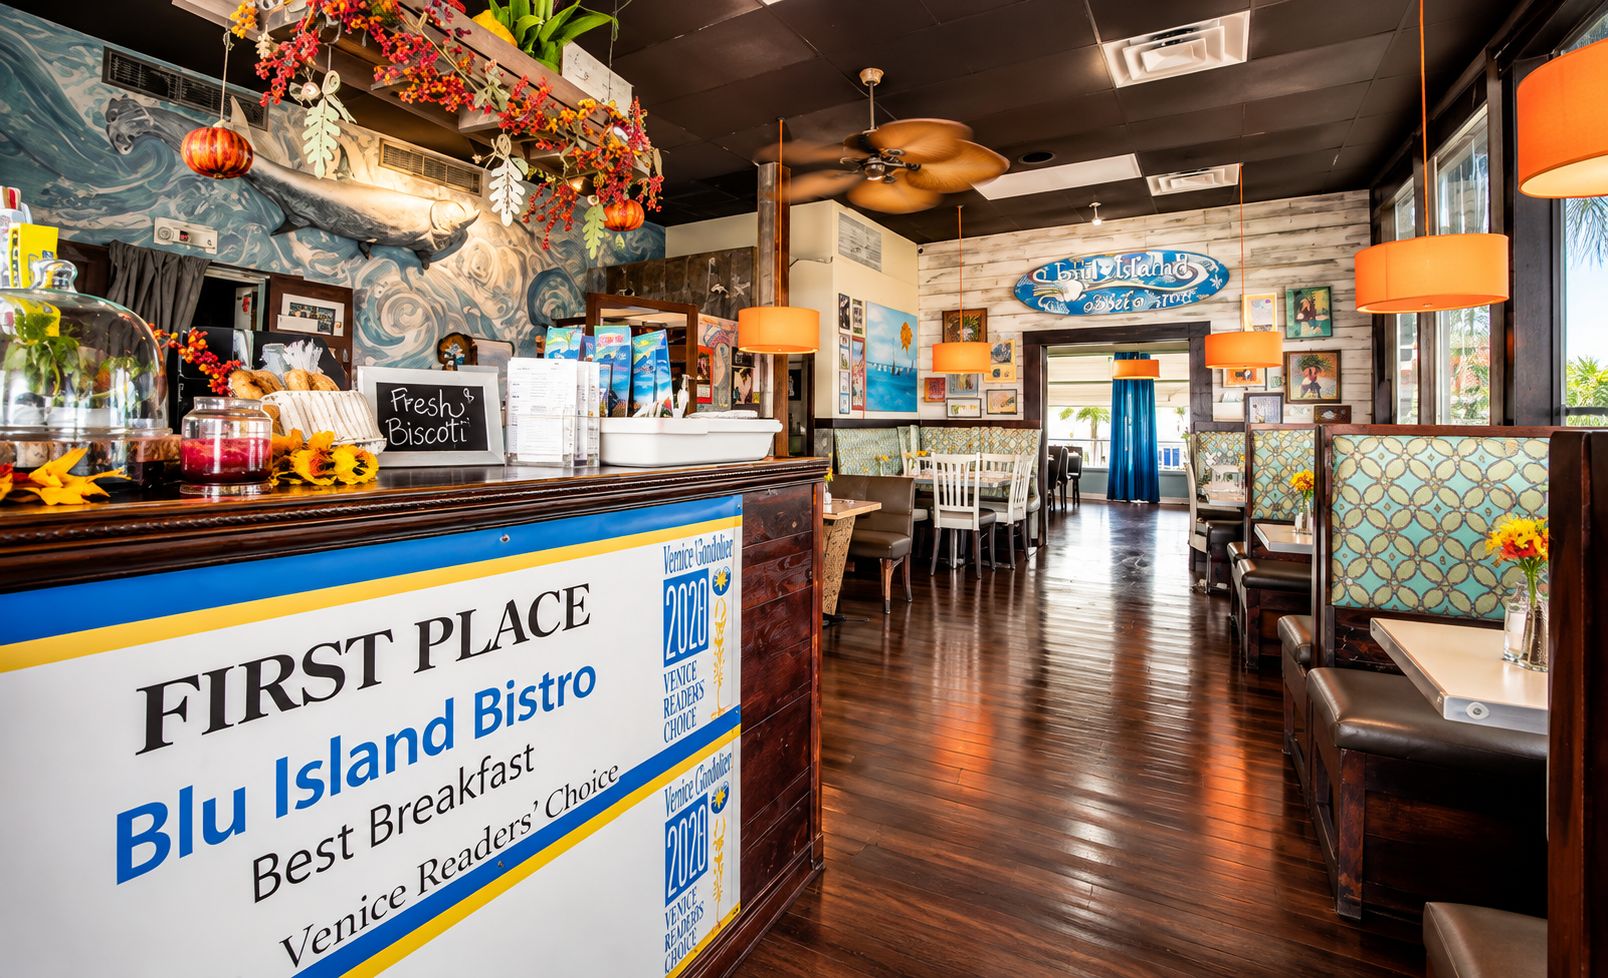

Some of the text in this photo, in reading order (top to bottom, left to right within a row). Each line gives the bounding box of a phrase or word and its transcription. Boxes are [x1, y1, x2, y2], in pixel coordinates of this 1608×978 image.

[390, 387, 465, 418] Fresh
[665, 577, 707, 660] 2020
[135, 582, 591, 756] FIRST PLACE
[663, 660, 697, 695] VENICE
[663, 706, 697, 743] CHOICE
[116, 665, 597, 885] Blu Island Bistro
[252, 743, 536, 904] Best Breakfast
[667, 804, 706, 899] 2020
[279, 883, 407, 968] Venice
[544, 764, 620, 819] Choice
[664, 886, 698, 930] VENICE
[664, 927, 697, 975] CHOICE
